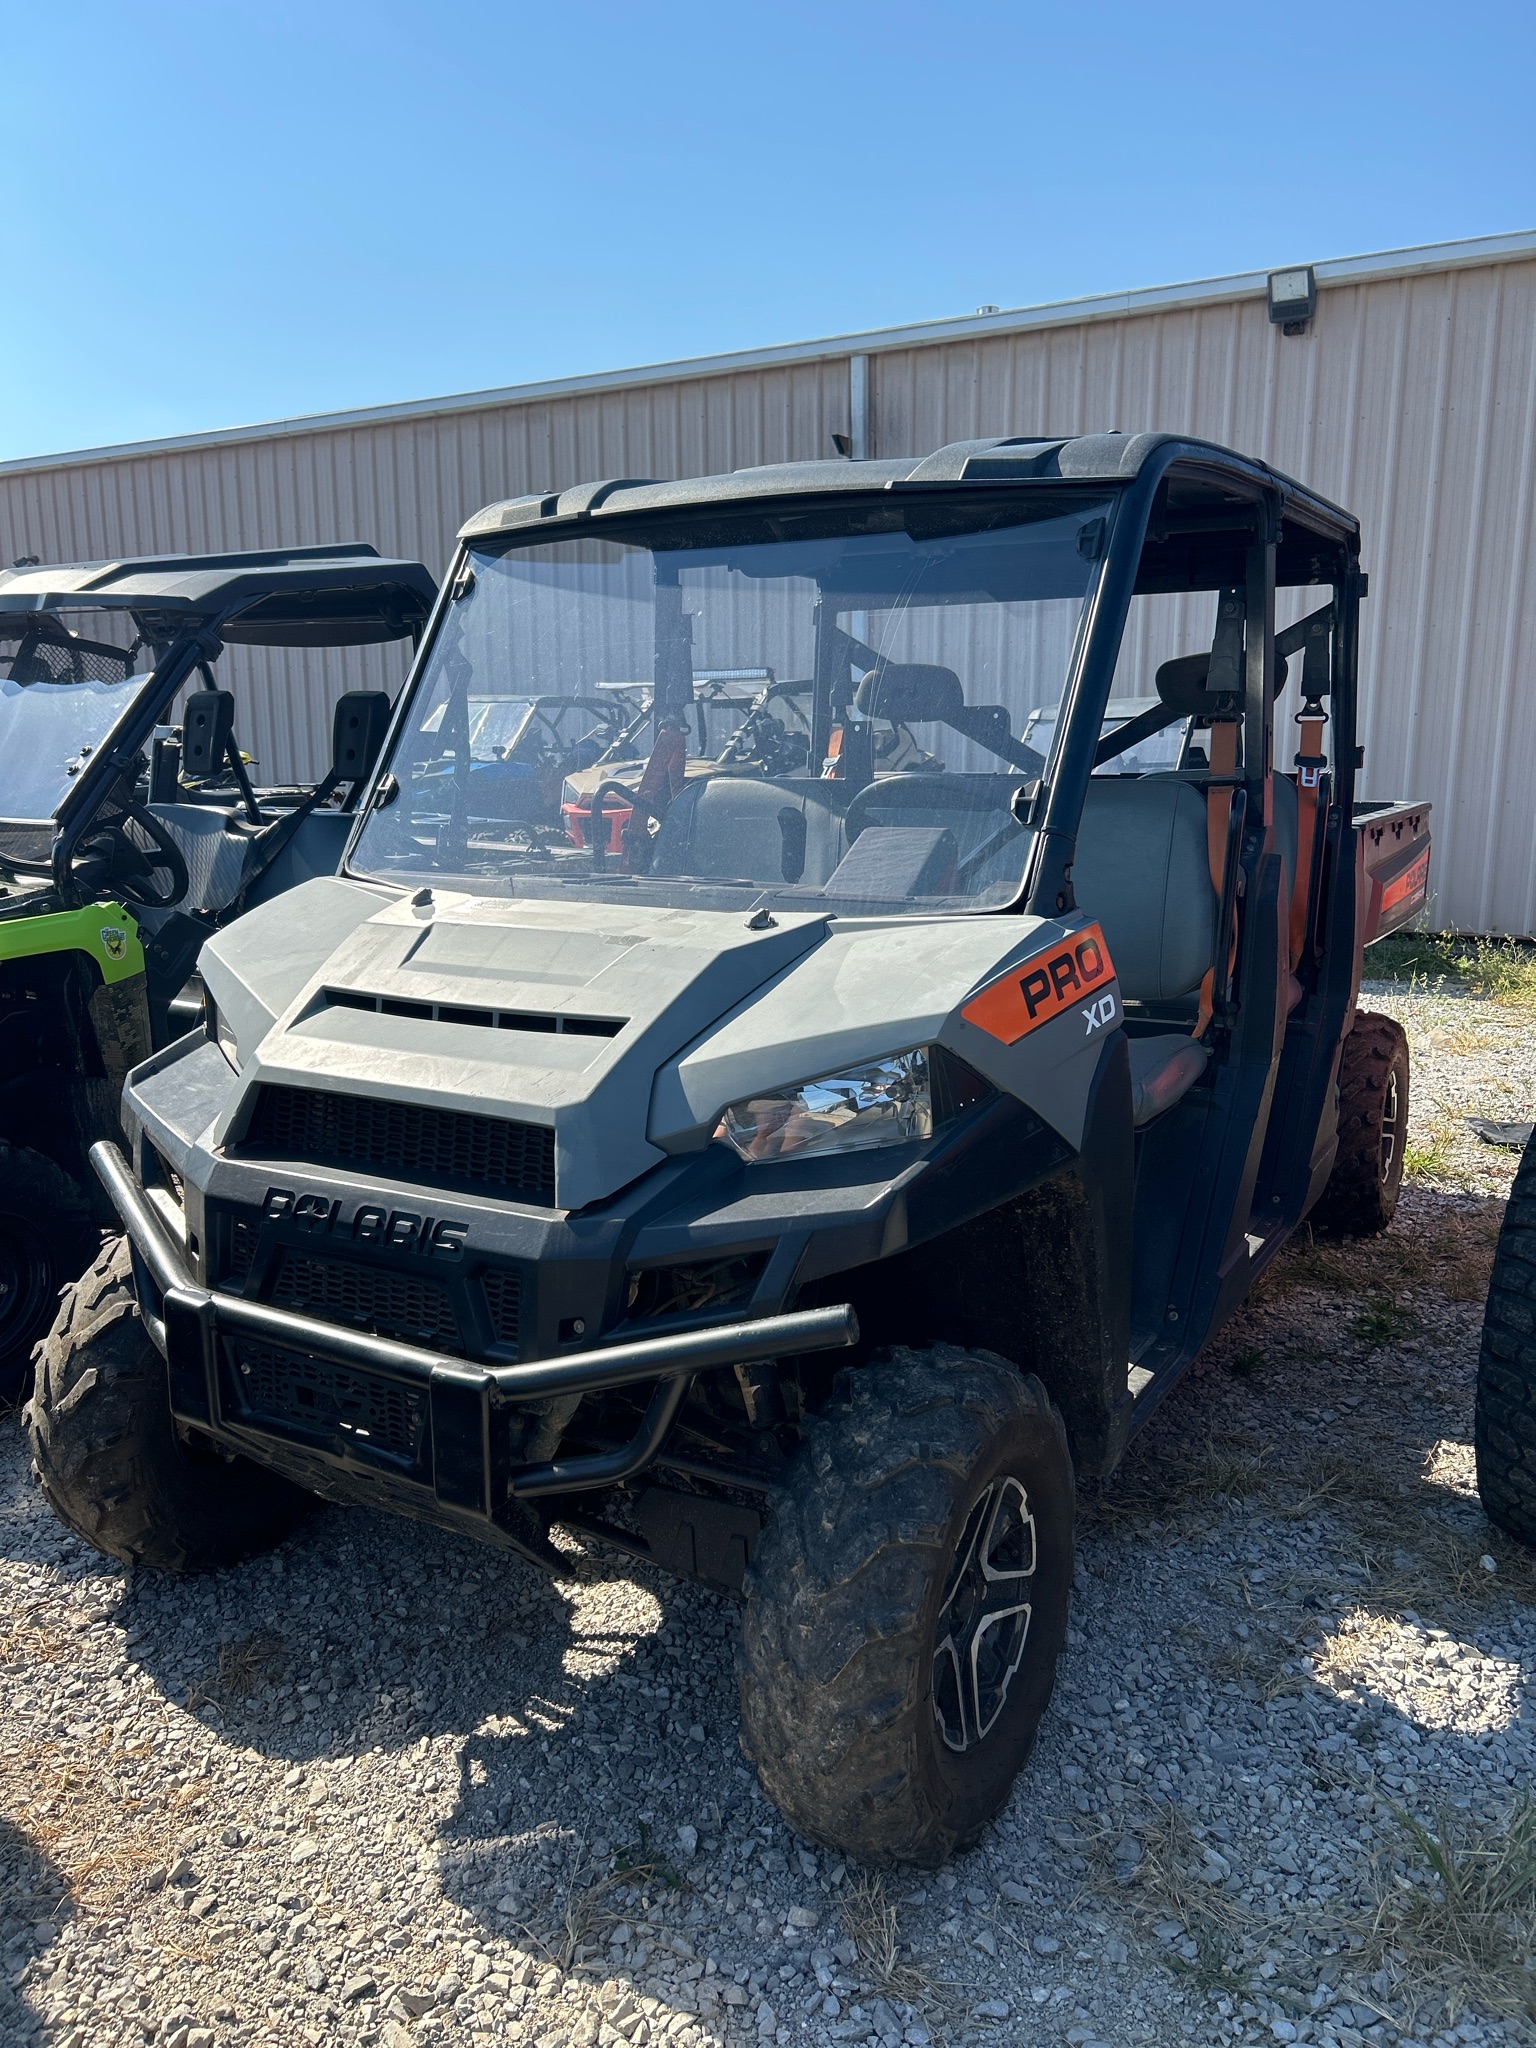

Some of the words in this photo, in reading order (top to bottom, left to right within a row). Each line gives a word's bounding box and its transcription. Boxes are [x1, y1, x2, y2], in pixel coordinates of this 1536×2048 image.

[1020, 938, 1103, 1019] PRO
[1082, 993, 1116, 1035] XD
[262, 1187, 470, 1262] POLARIS
